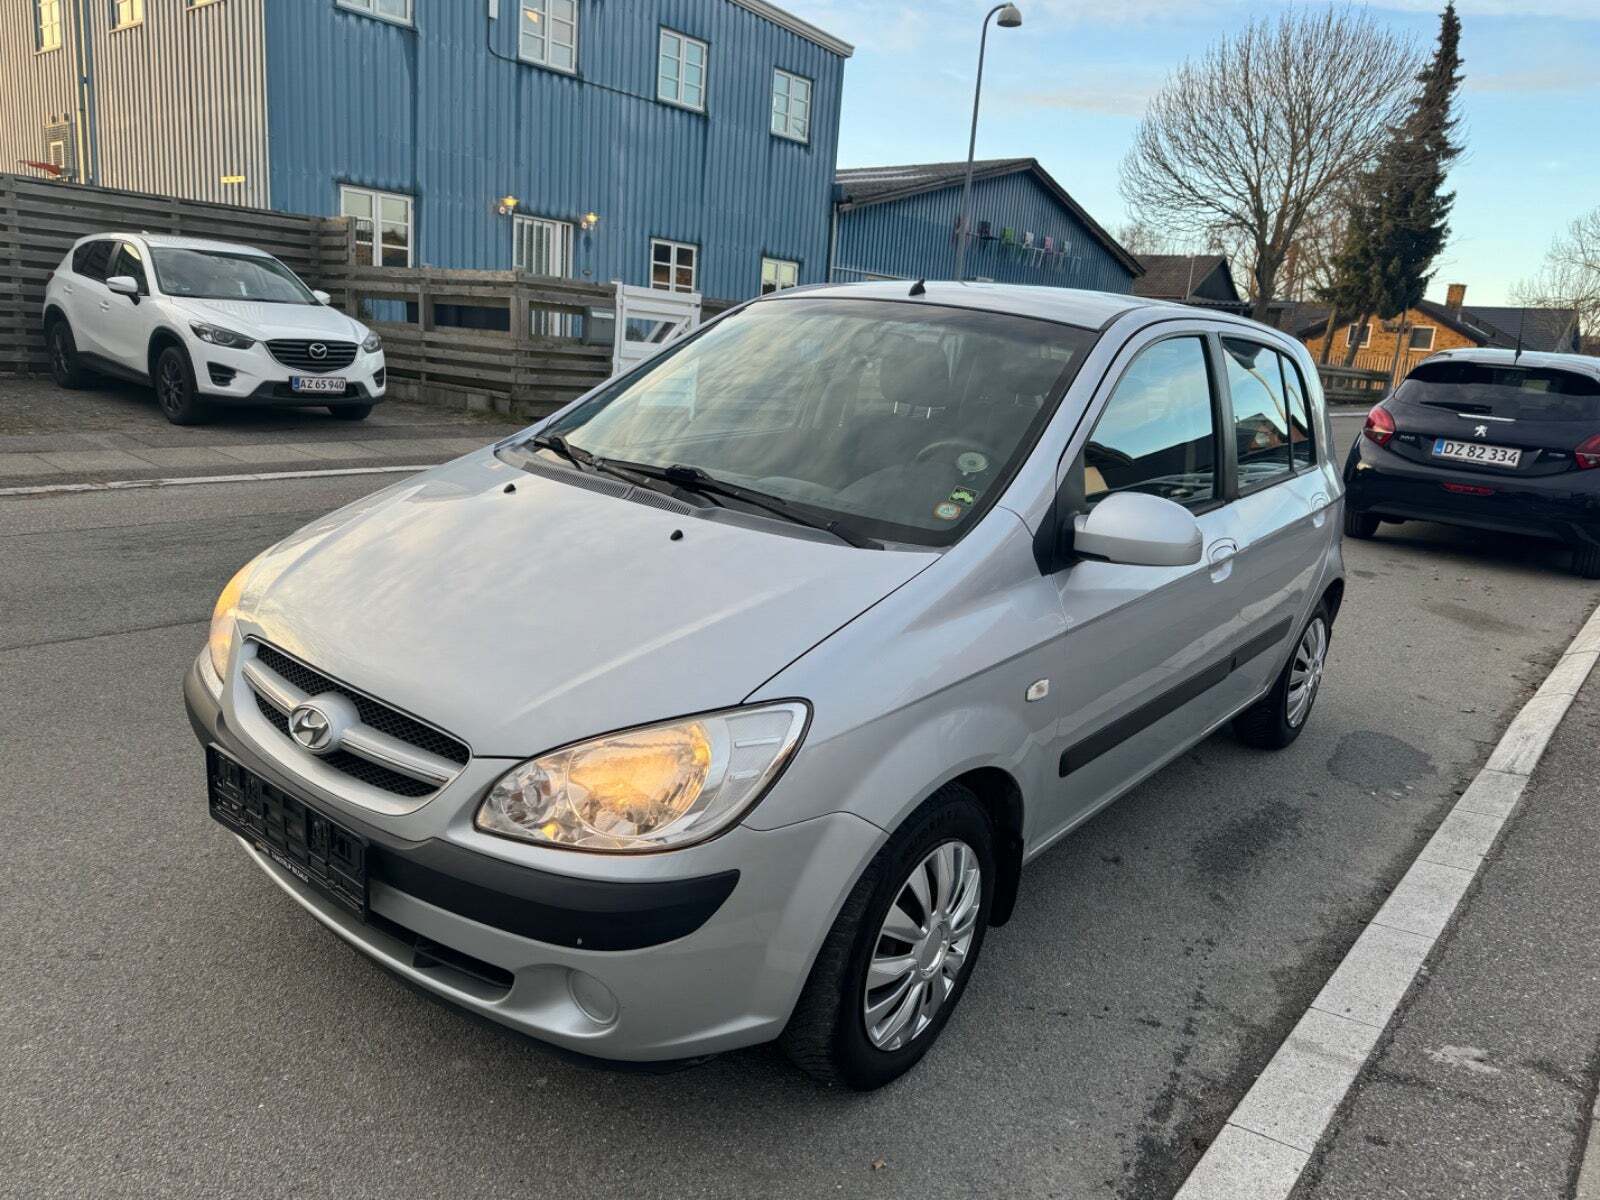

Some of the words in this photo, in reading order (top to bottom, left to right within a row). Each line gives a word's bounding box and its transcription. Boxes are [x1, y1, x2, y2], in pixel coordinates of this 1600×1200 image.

[301, 379, 313, 389] AZ
[315, 380, 327, 390] 65
[328, 380, 345, 390] 940
[1444, 442, 1465, 456] DZ
[1467, 445, 1486, 459] 82
[1488, 448, 1518, 465] 334
